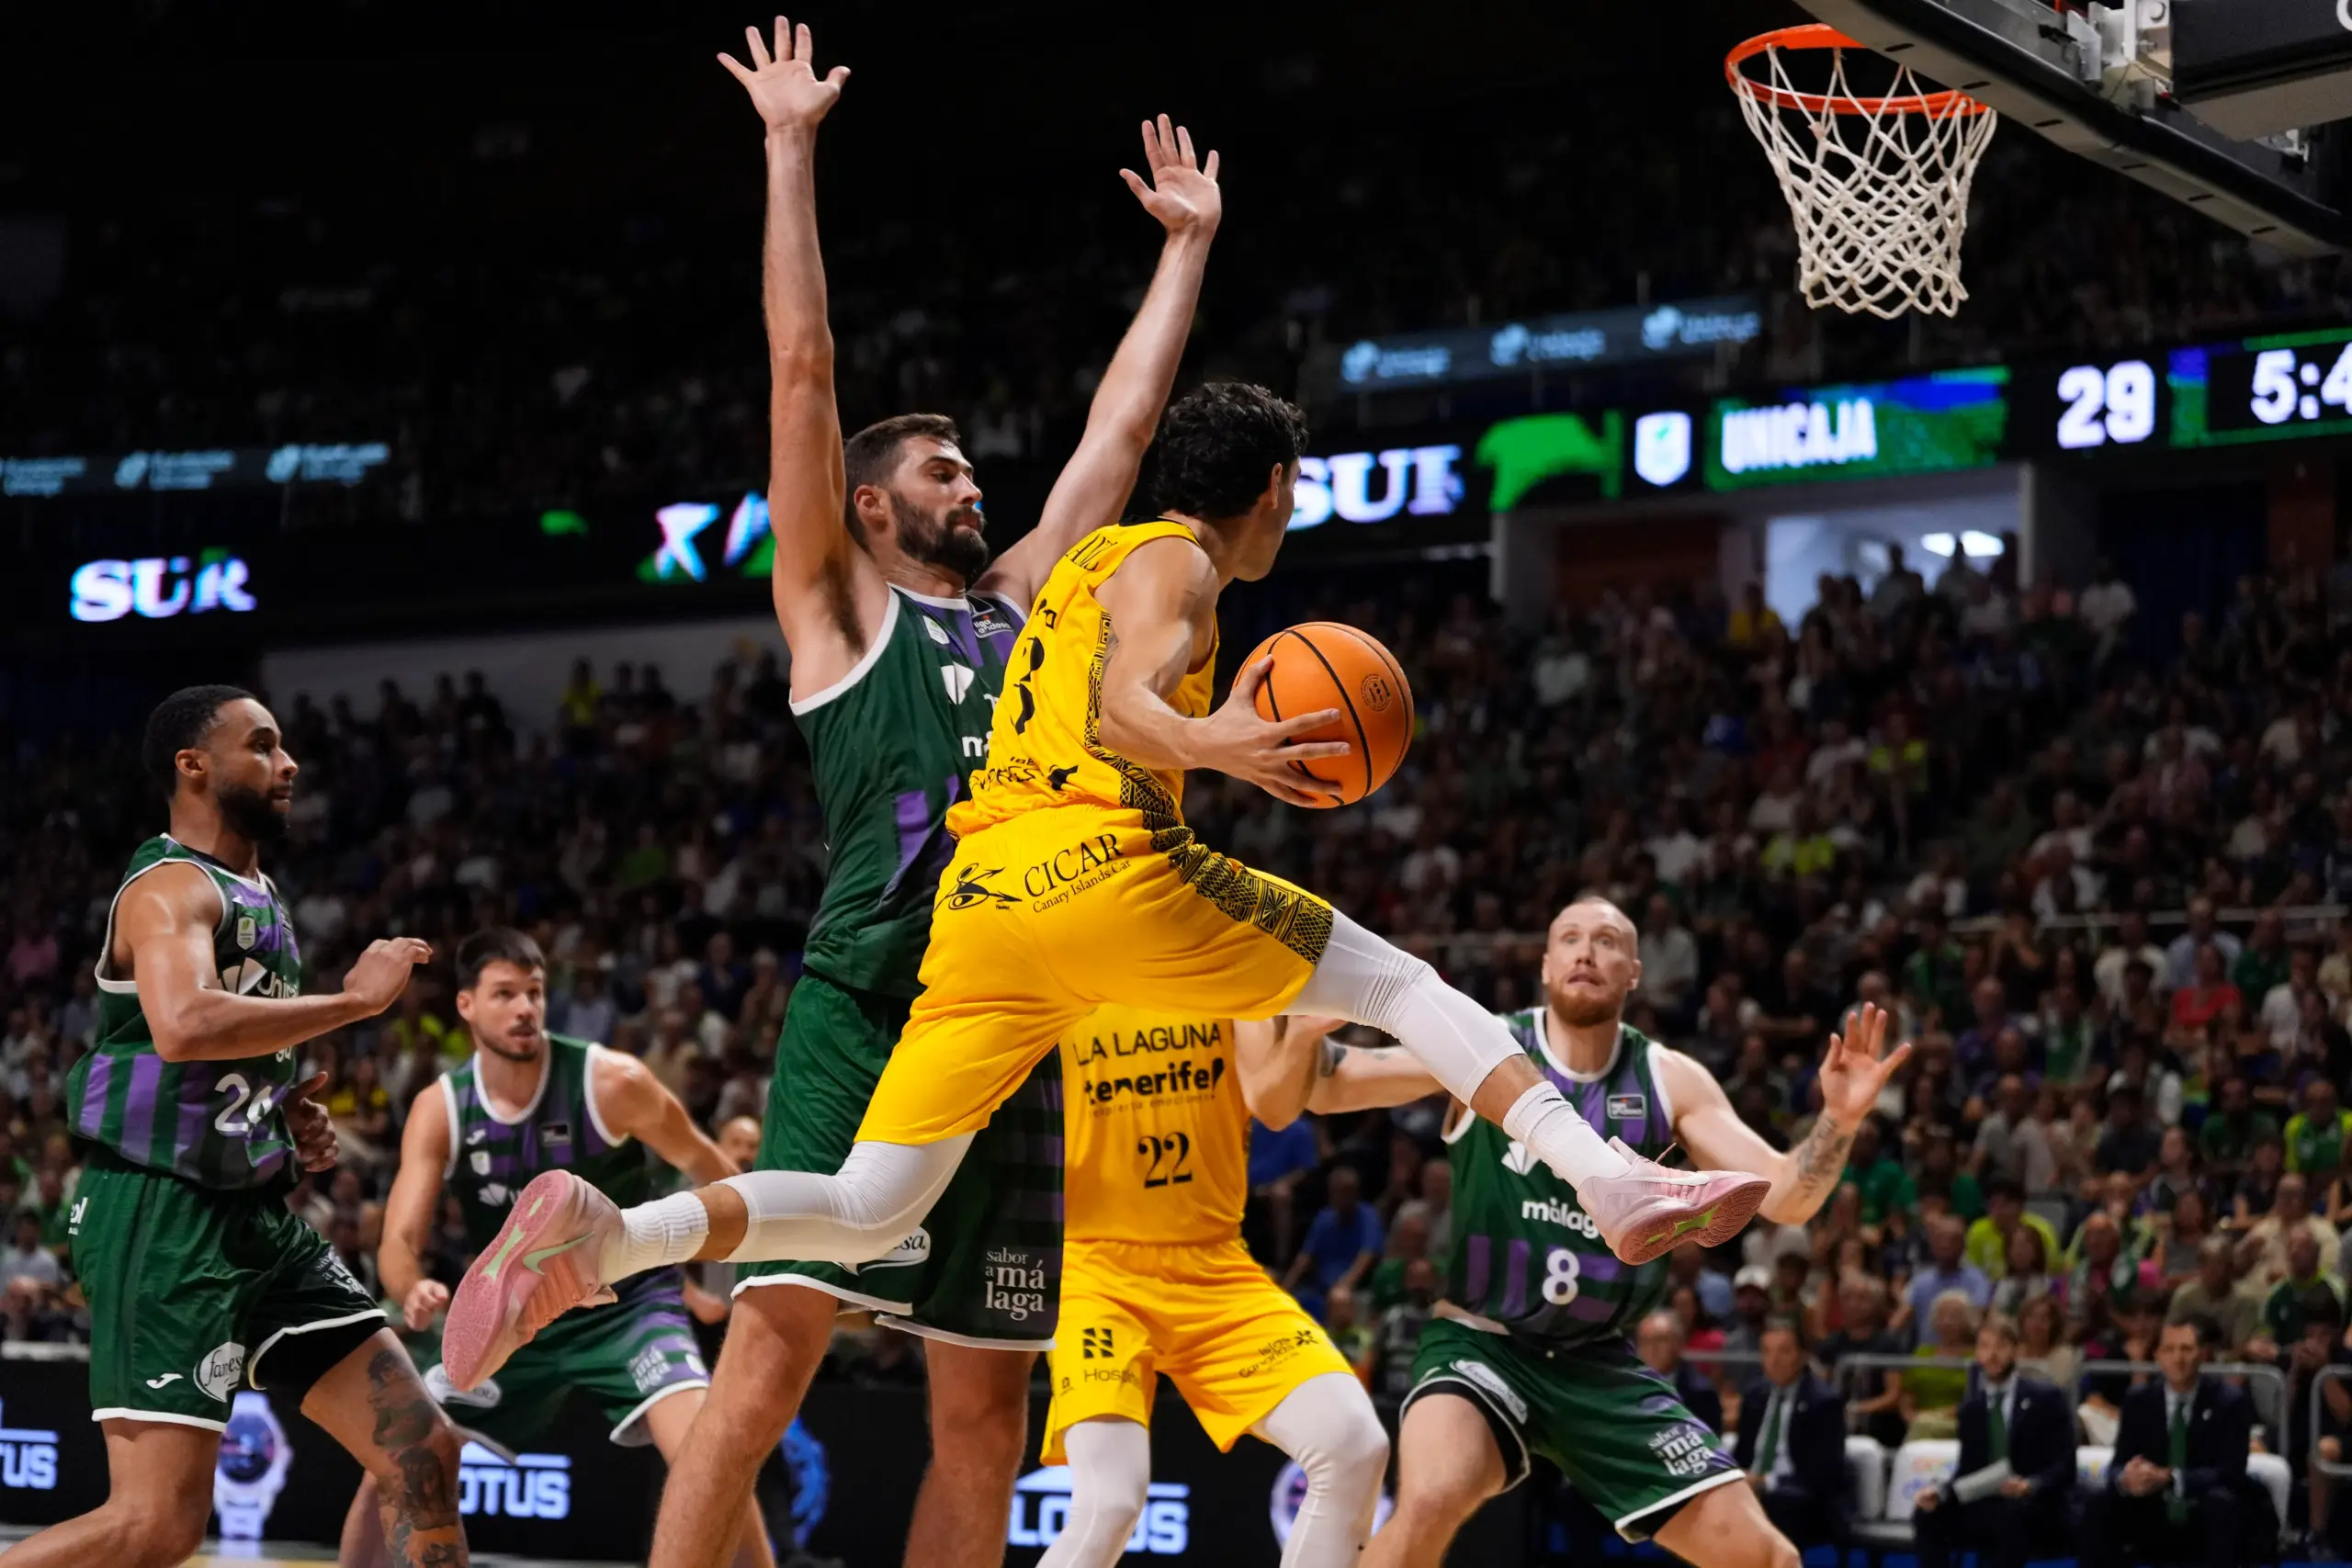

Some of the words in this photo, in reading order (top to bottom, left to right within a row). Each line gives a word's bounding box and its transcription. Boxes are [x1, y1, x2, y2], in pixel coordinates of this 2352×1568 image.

[2057, 360, 2155, 449] 29
[1722, 398, 1877, 474] UNICAJA
[1024, 833, 1124, 897] CICAR
[1033, 889, 1069, 913] Canary
[1070, 868, 1111, 895] Islands
[1110, 859, 1132, 874] Car
[1072, 1037, 1108, 1066] LA
[1113, 1023, 1222, 1056] LAGUNA
[1136, 1131, 1193, 1189] 22
[985, 1266, 994, 1277] a
[995, 1259, 1046, 1290] má
[986, 1247, 1029, 1265] sabor
[1542, 1248, 1580, 1305] 8
[985, 1280, 1046, 1321] laga
[458, 1466, 571, 1518] OTUS
[1008, 1494, 1189, 1555] LOUS
